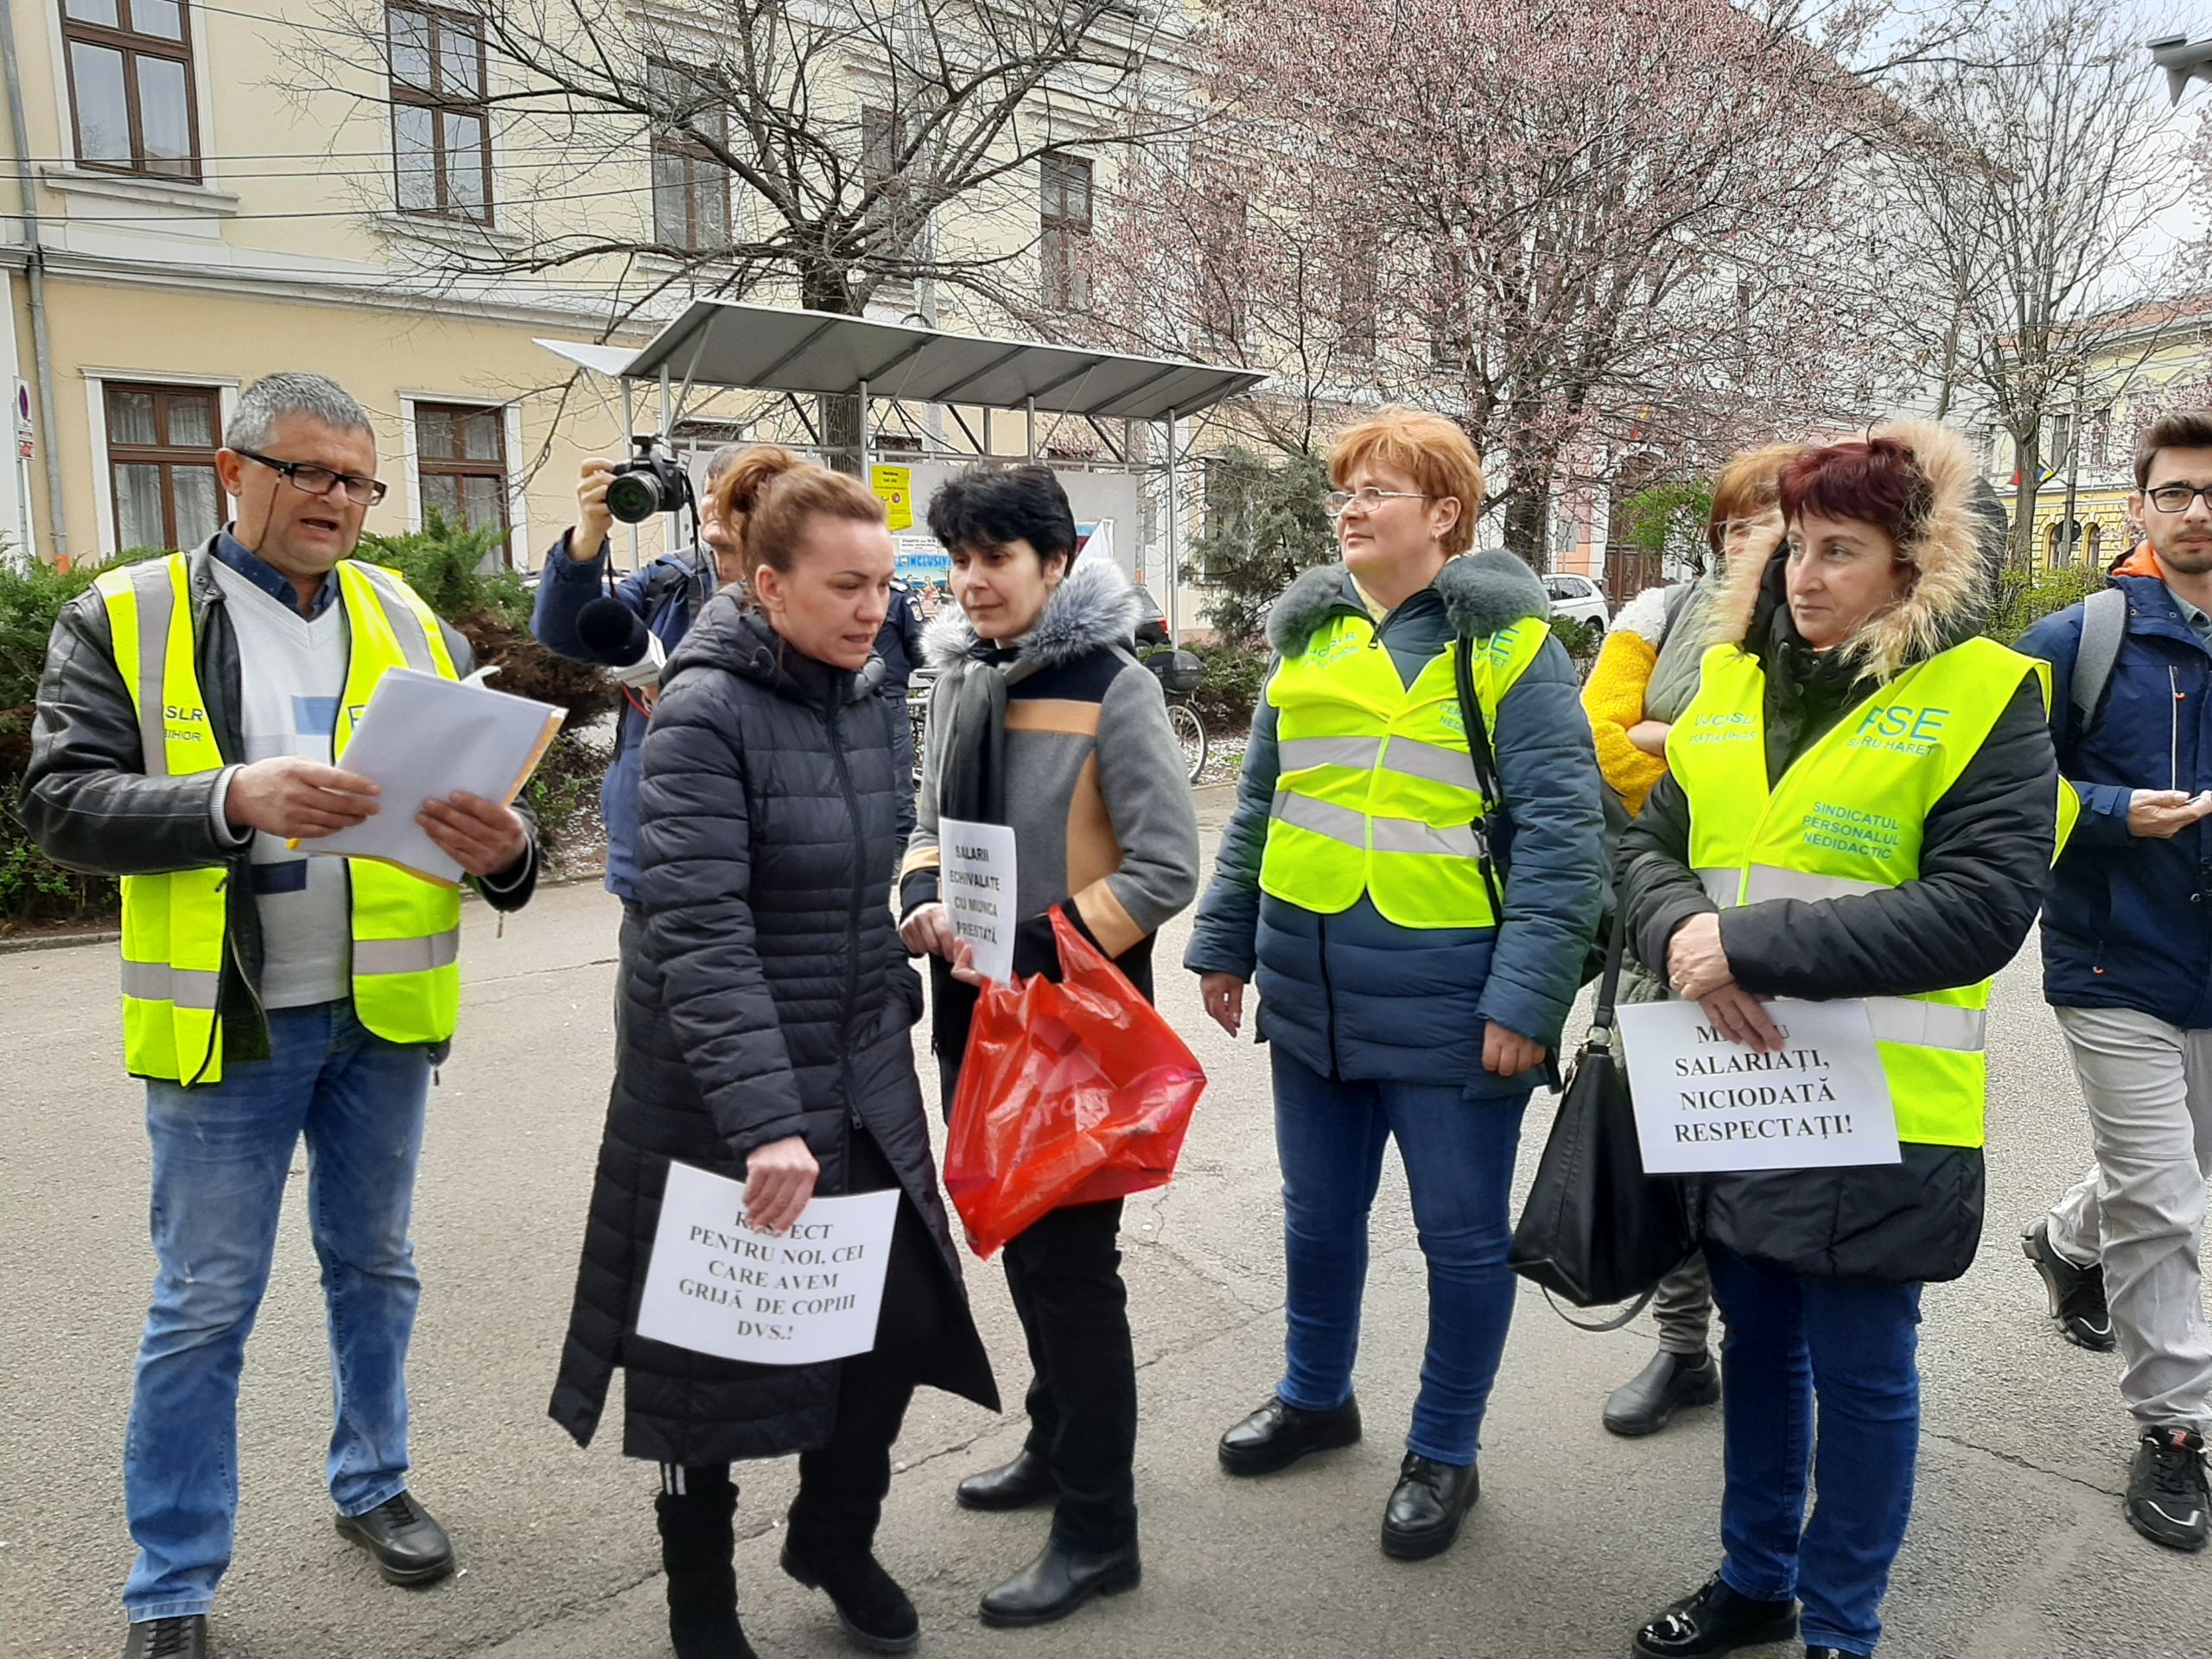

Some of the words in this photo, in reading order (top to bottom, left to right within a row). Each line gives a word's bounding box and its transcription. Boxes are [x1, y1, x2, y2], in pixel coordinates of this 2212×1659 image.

[1855, 705, 1950, 741] FSE
[1884, 741, 1936, 756] HARET
[1802, 814, 1899, 845] PERSONALUL
[1813, 801, 1898, 830] SINDICATUL
[955, 845, 989, 862] SALARII
[1802, 831, 1891, 859] NEDIDACTIC
[950, 869, 1001, 891] ECHIVALATE
[955, 896, 967, 910] CU
[1680, 1077, 1837, 1110] NICIODATĂ
[734, 1211, 834, 1240] RECT
[689, 1225, 775, 1262] PENTRU
[832, 1244, 864, 1263] CEI
[709, 1260, 768, 1288] CARE
[774, 1273, 838, 1290] AVEM
[678, 1278, 742, 1309] GRIJĂ
[755, 1297, 786, 1314] DE
[791, 1294, 855, 1315] COPIII
[737, 1319, 793, 1340] DVS.!
